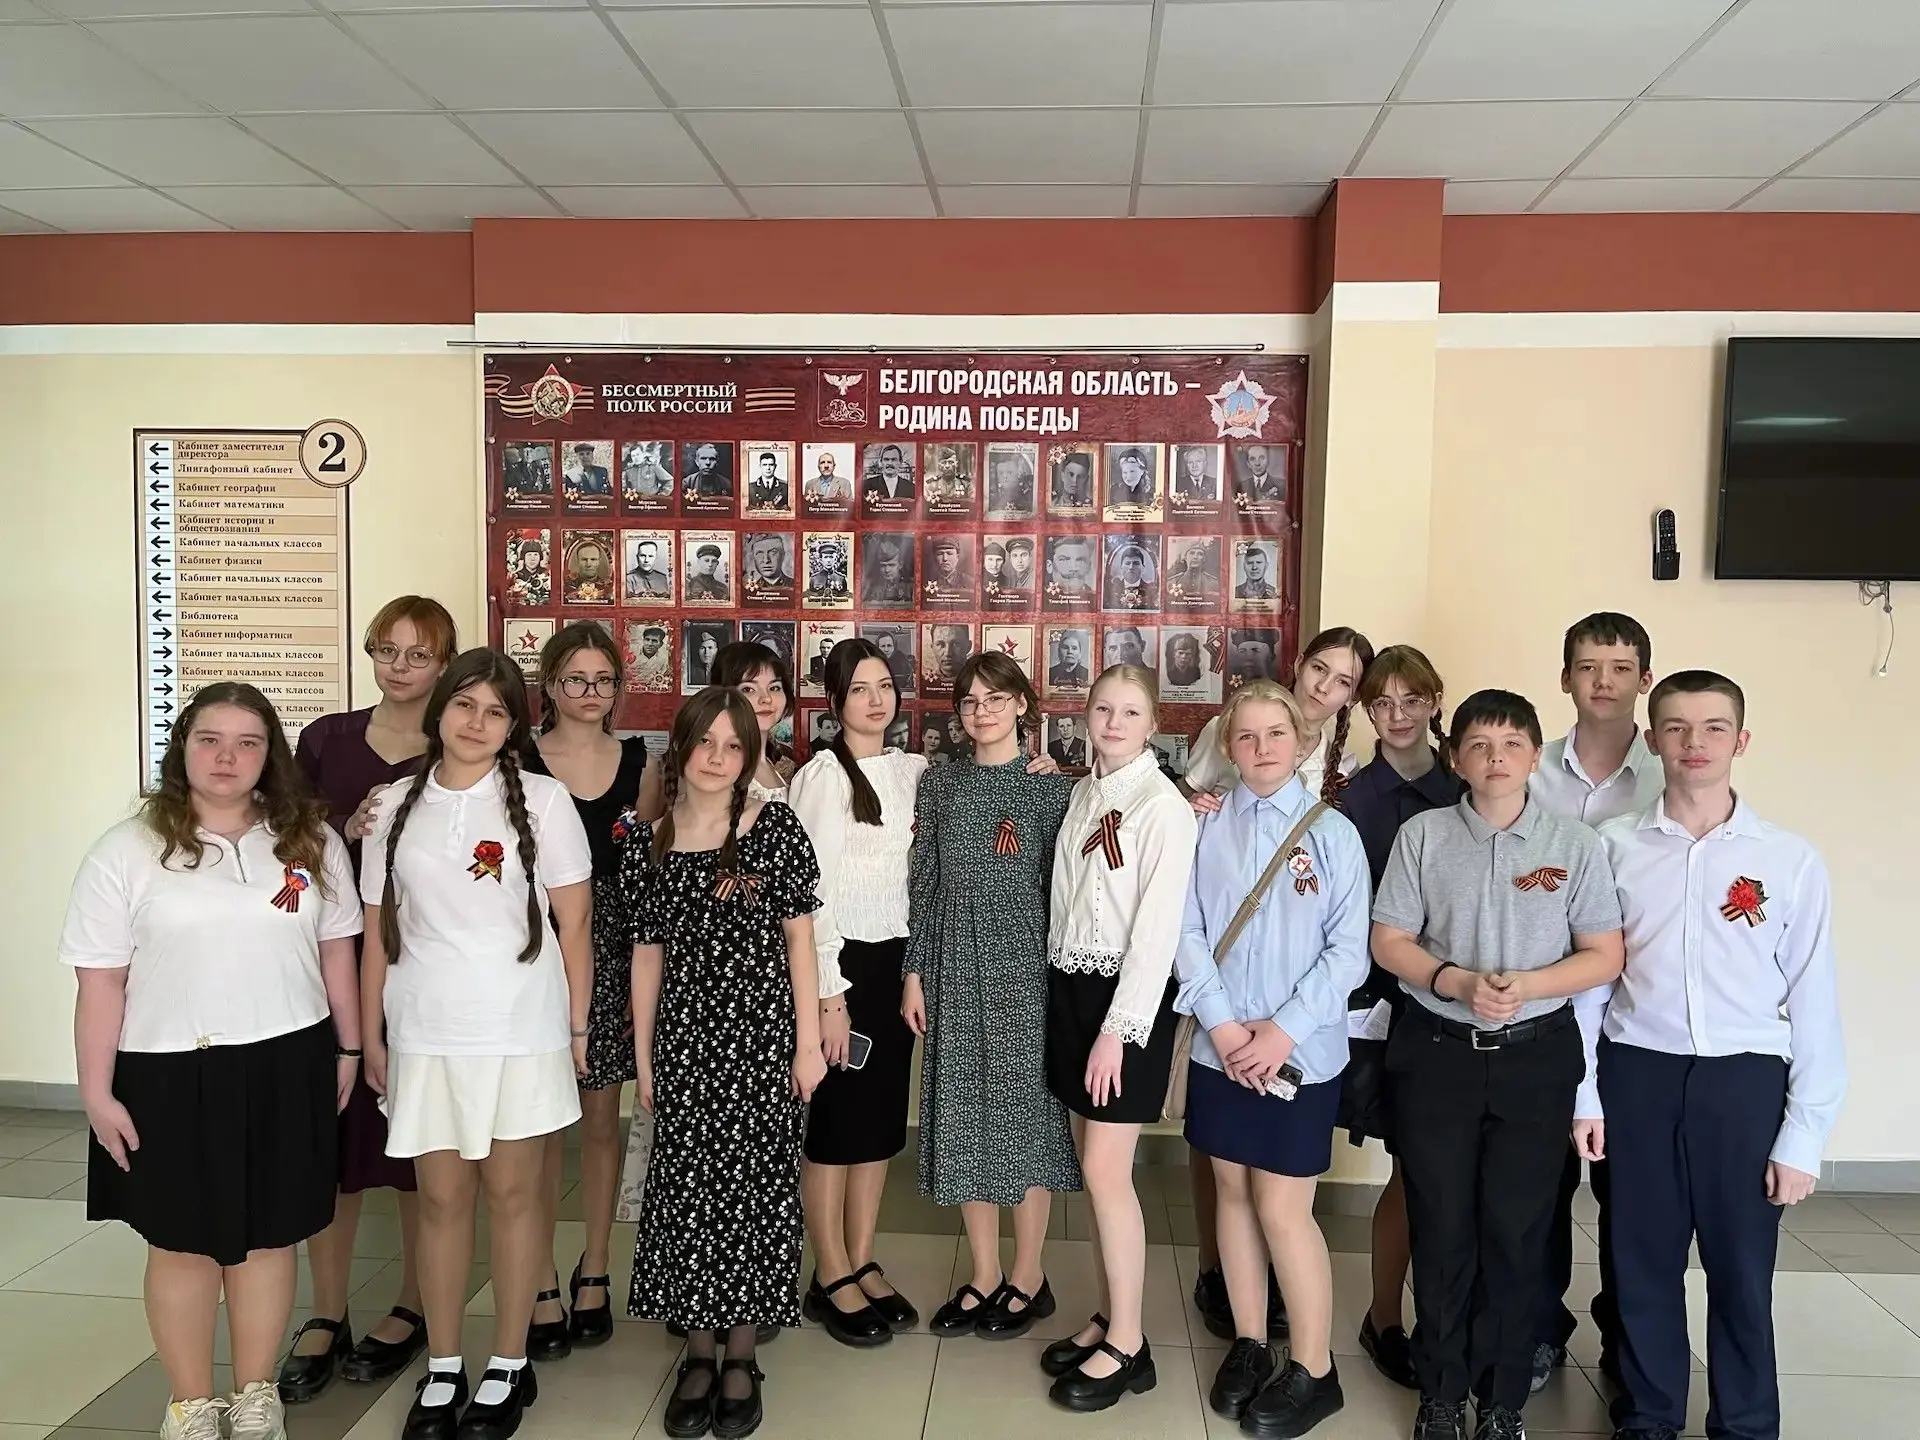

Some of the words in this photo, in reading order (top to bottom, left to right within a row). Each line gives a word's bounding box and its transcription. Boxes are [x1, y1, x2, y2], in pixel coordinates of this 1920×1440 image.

[879, 369, 1063, 397] БЕЛГОРОДСКАЯ
[1071, 370, 1179, 396] ОБЛАСТЬ
[602, 382, 737, 398] БЕССМЕРТНЫЙ
[607, 400, 657, 413] ПОЛК
[660, 400, 732, 414] РОССИИ
[879, 404, 972, 433] РОДИНА
[980, 405, 1079, 435] ПОБЕДЫ
[177, 441, 219, 450] Кабинет
[222, 443, 285, 451] заместителя
[177, 451, 229, 459] директора
[318, 432, 346, 472] 2
[177, 464, 250, 474] Лингафонный
[253, 466, 294, 474] кабинет
[178, 482, 220, 492] Кабинет
[223, 485, 276, 494] географии
[178, 499, 220, 508] Кабинет
[223, 501, 285, 509] математики
[179, 515, 220, 524] Кабинет
[224, 517, 265, 525] истории
[179, 525, 260, 533] обществознания
[179, 537, 221, 547] Кабинет
[224, 540, 280, 548] начальных
[283, 540, 323, 548] классов
[179, 555, 221, 565] Кабинет
[224, 556, 263, 566] физики
[180, 573, 222, 582] Кабинет
[225, 575, 281, 583] начальных
[284, 576, 323, 584] классов
[180, 592, 222, 601] Кабинет
[225, 594, 281, 603] начальных
[284, 595, 323, 603] классов
[181, 611, 239, 621] Библиотека
[181, 629, 222, 638] Кабинет
[224, 631, 293, 640] информатики
[181, 648, 222, 658] Кабинет
[226, 650, 282, 659] начальных
[285, 651, 324, 659] классов
[181, 666, 223, 676] Кабинет
[226, 669, 282, 677] начальных
[285, 669, 324, 678] классов
[285, 687, 324, 695] классов
[285, 705, 325, 713] классов
